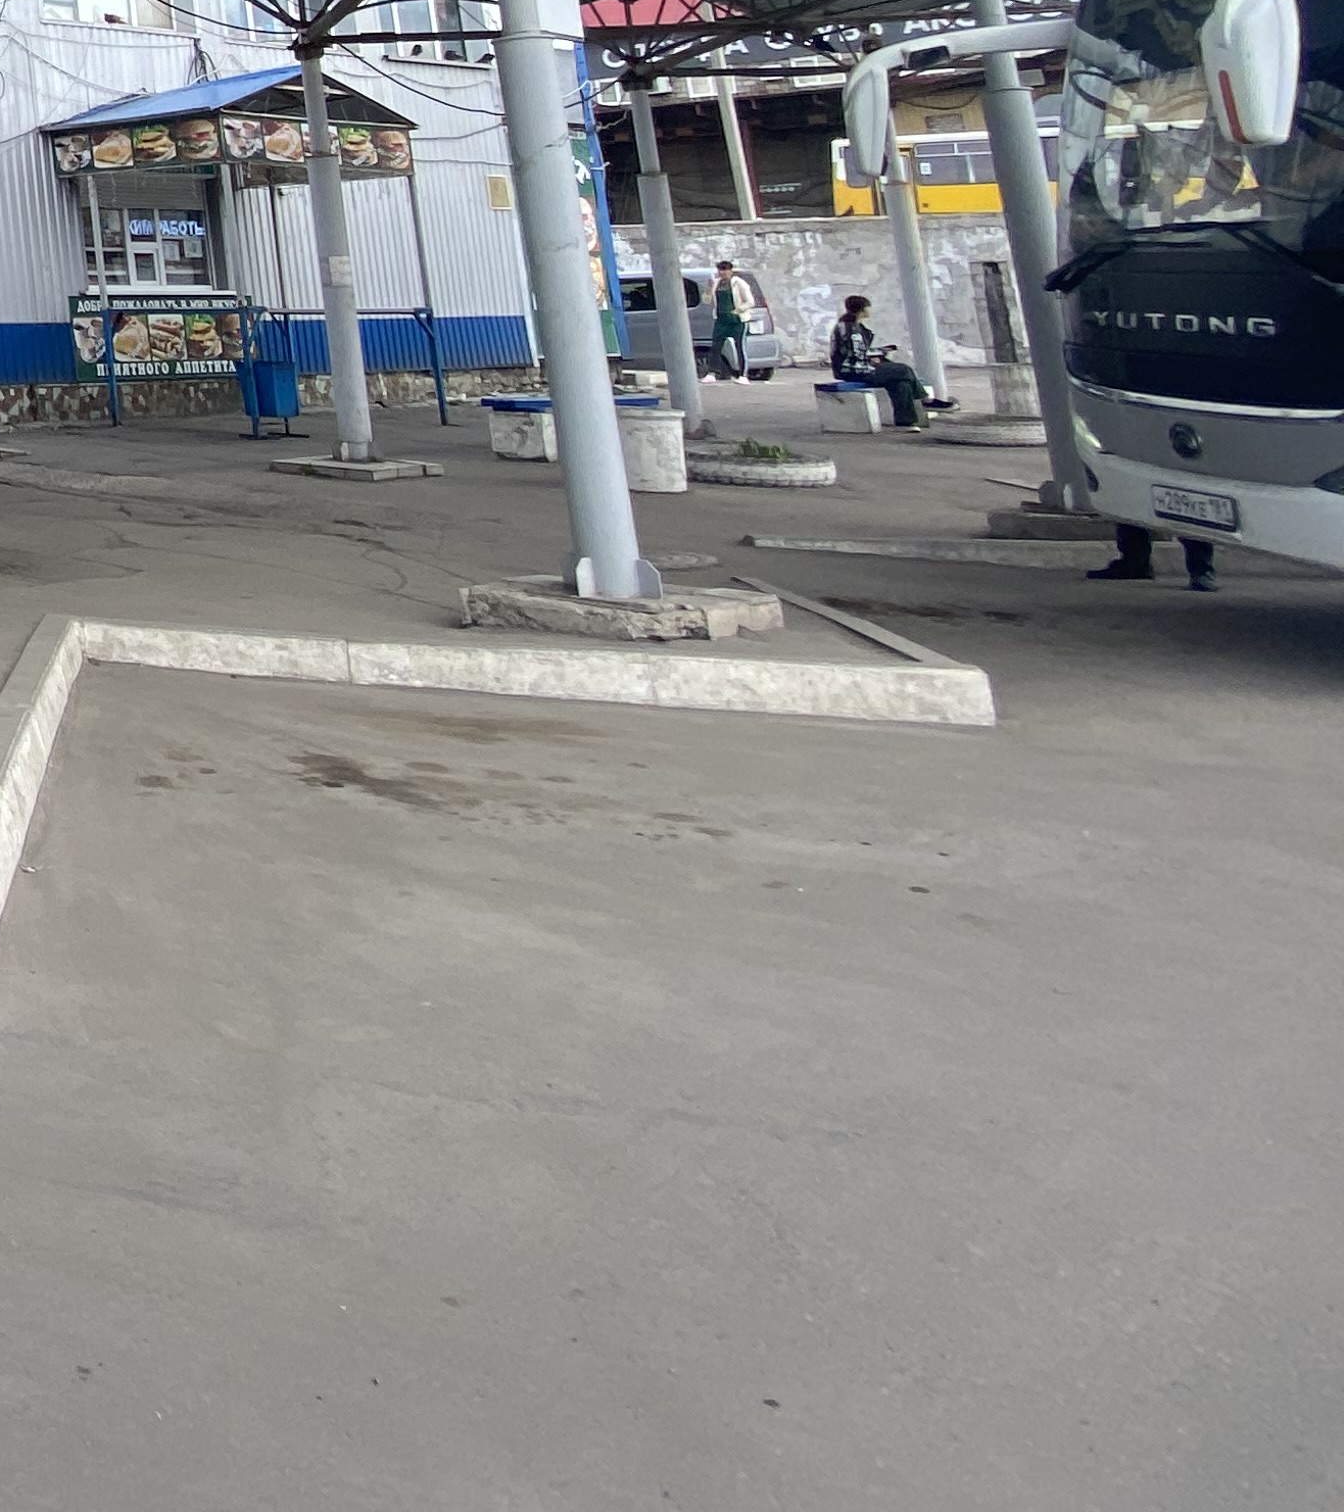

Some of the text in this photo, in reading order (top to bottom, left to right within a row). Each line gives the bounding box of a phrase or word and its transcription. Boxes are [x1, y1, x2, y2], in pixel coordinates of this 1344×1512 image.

[1093, 309, 1277, 338] YUTONG
[96, 359, 237, 377] ПИЯТНОГО АППЕТИТА
